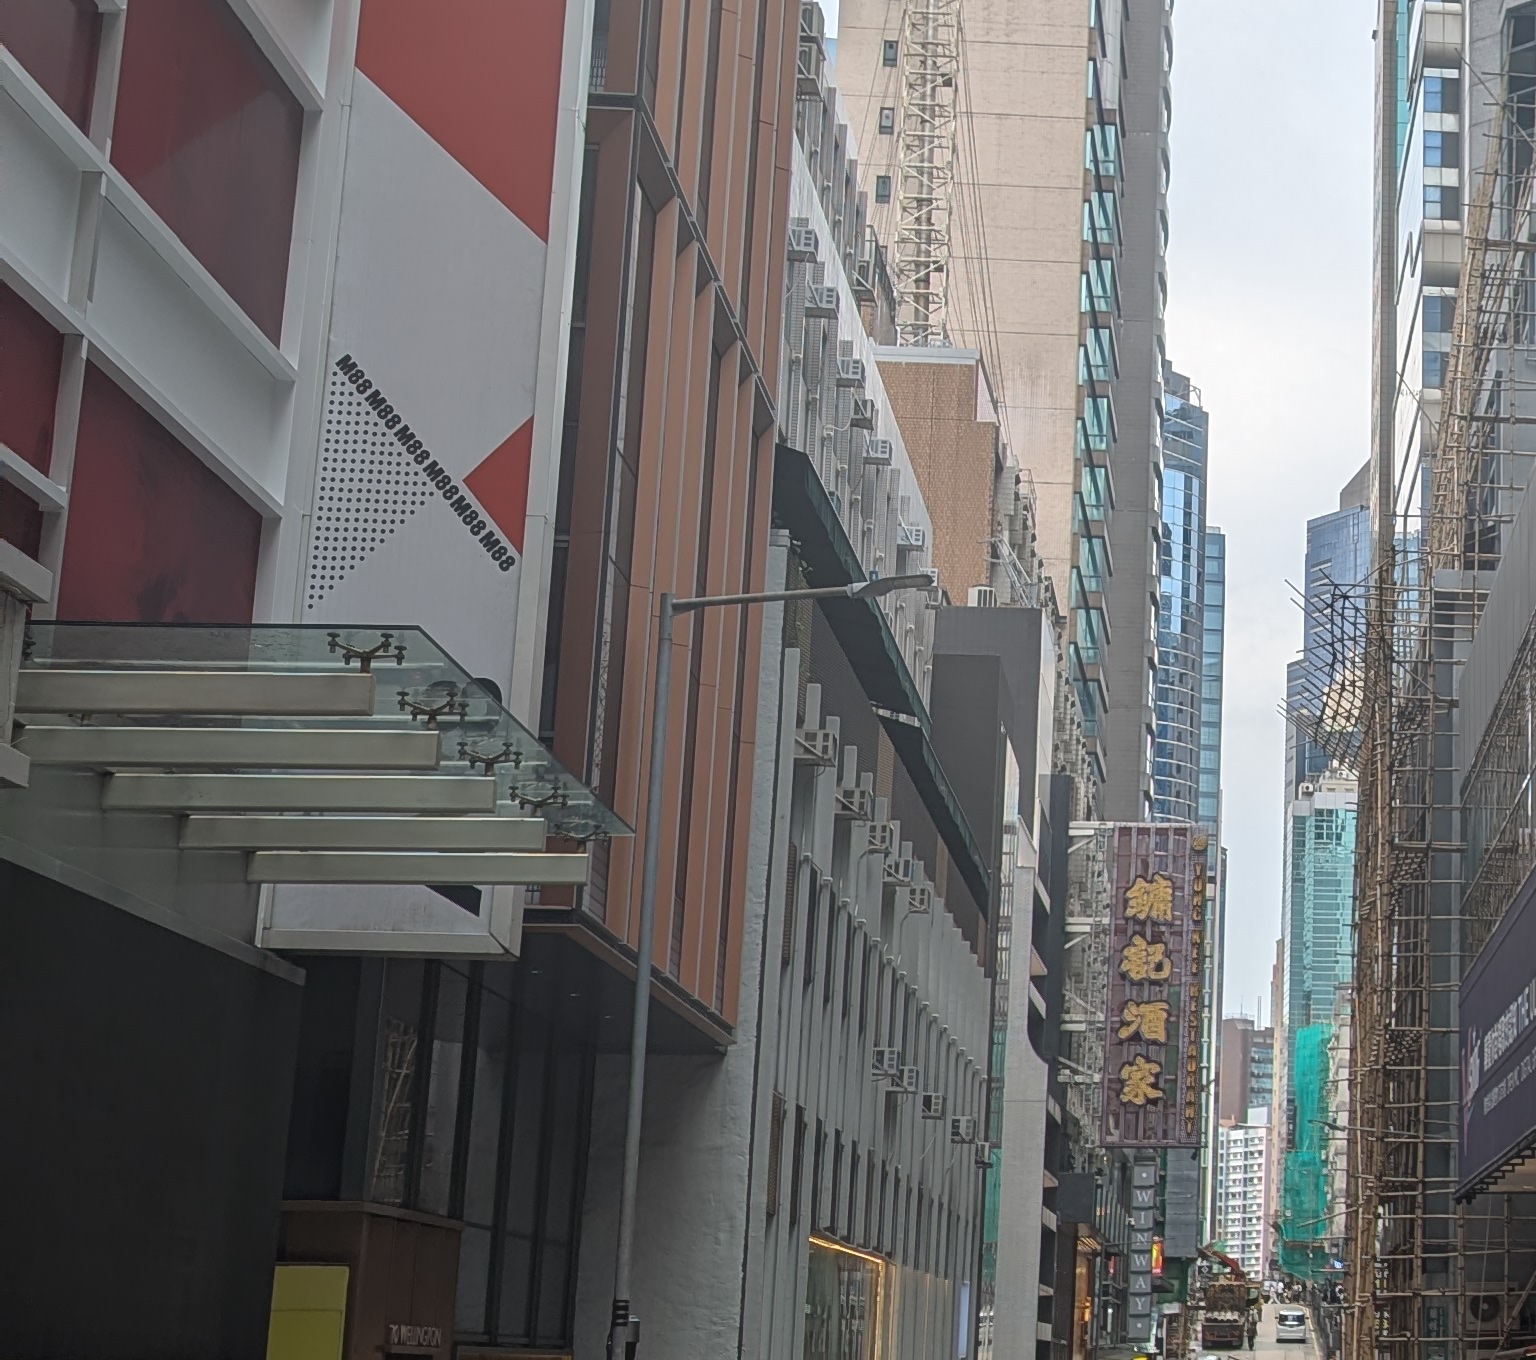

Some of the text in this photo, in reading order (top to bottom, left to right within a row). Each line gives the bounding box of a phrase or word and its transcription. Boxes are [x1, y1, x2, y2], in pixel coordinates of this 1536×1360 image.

[334, 353, 516, 572] M88 M88 M88 M88 M88 M88
[1116, 871, 1174, 1108] 鏞記酒家
[1134, 1190, 1152, 1311] WINWAY
